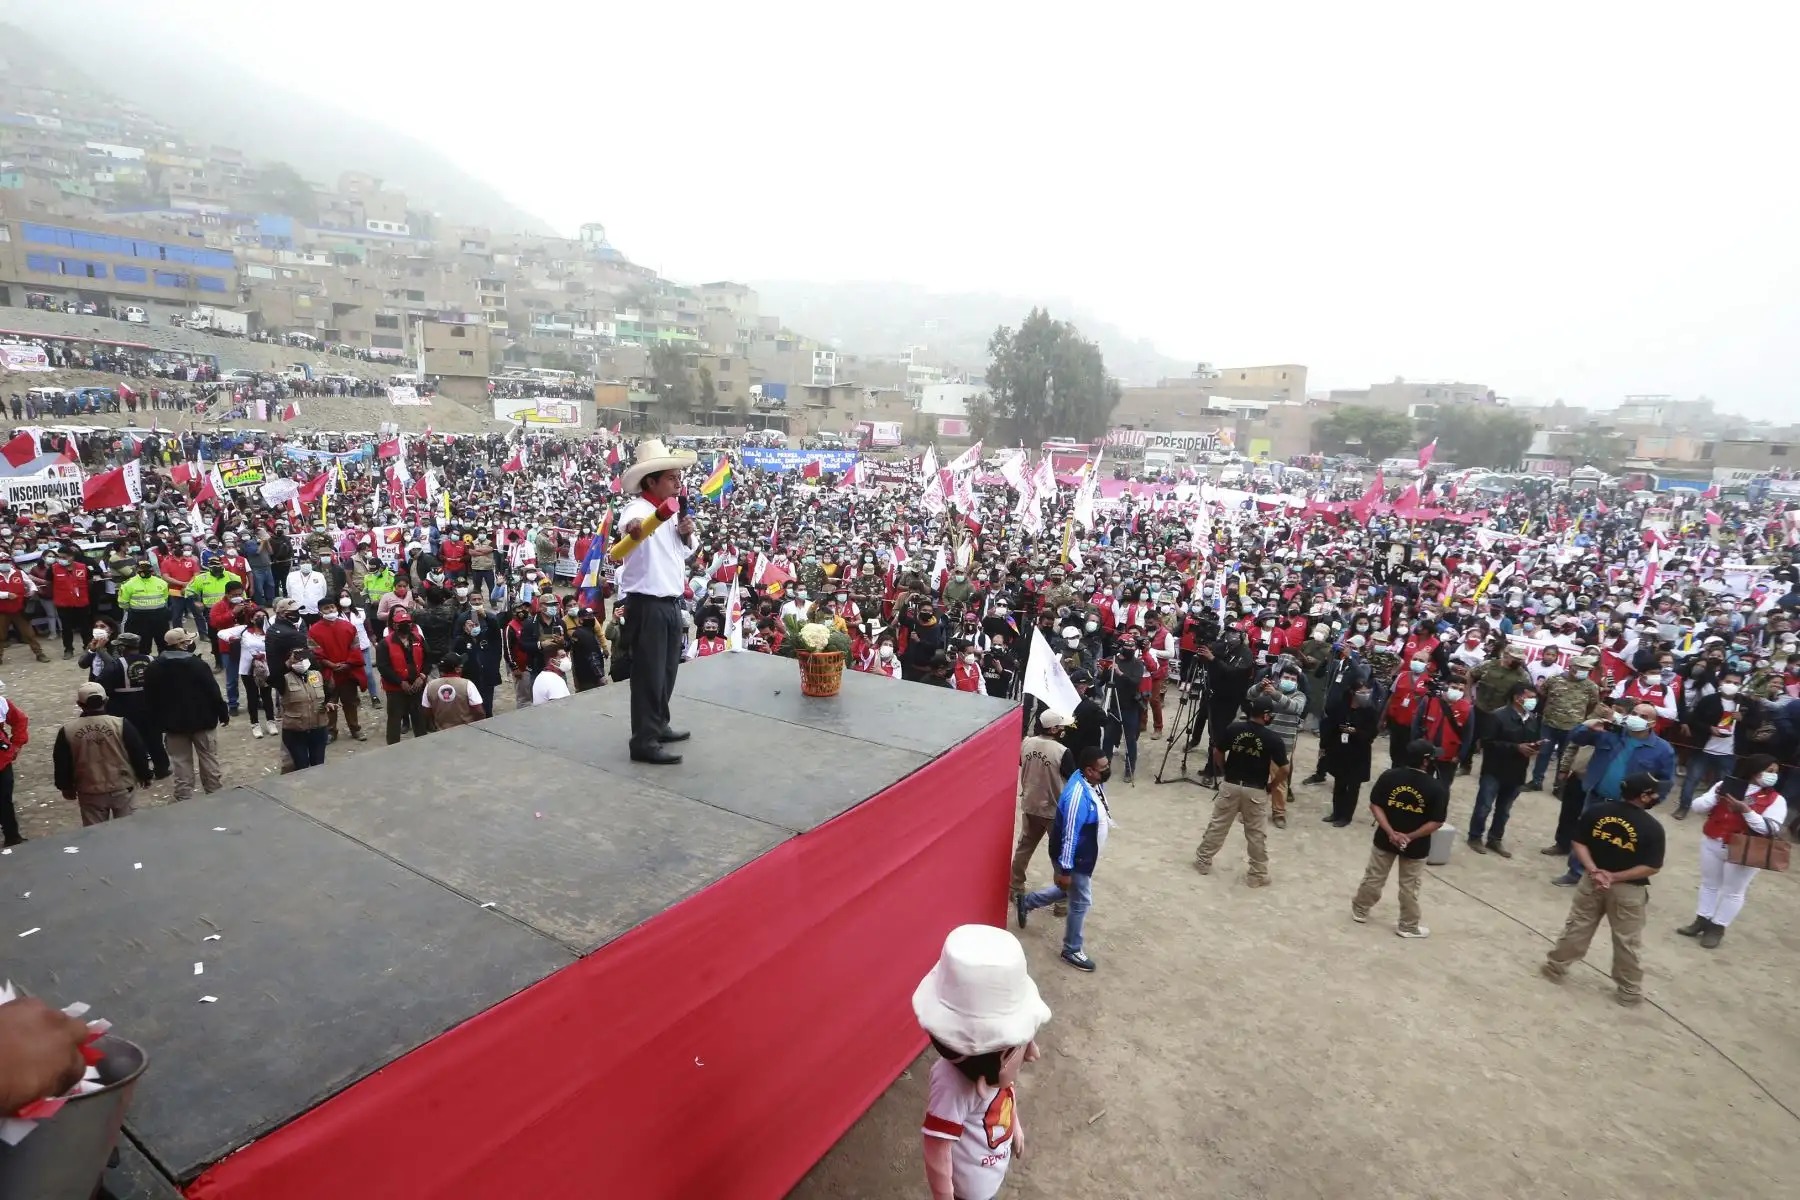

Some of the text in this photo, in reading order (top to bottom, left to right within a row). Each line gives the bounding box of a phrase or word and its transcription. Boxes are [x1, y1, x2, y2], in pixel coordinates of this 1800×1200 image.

[1155, 434, 1221, 451] PRESIDENTE
[9, 480, 82, 502] INSCRIPCIÓN DE
[1025, 750, 1052, 768] DIRSEG
[1388, 785, 1426, 807] LICENCIADOS
[1594, 816, 1638, 843] LICENCIADOS
